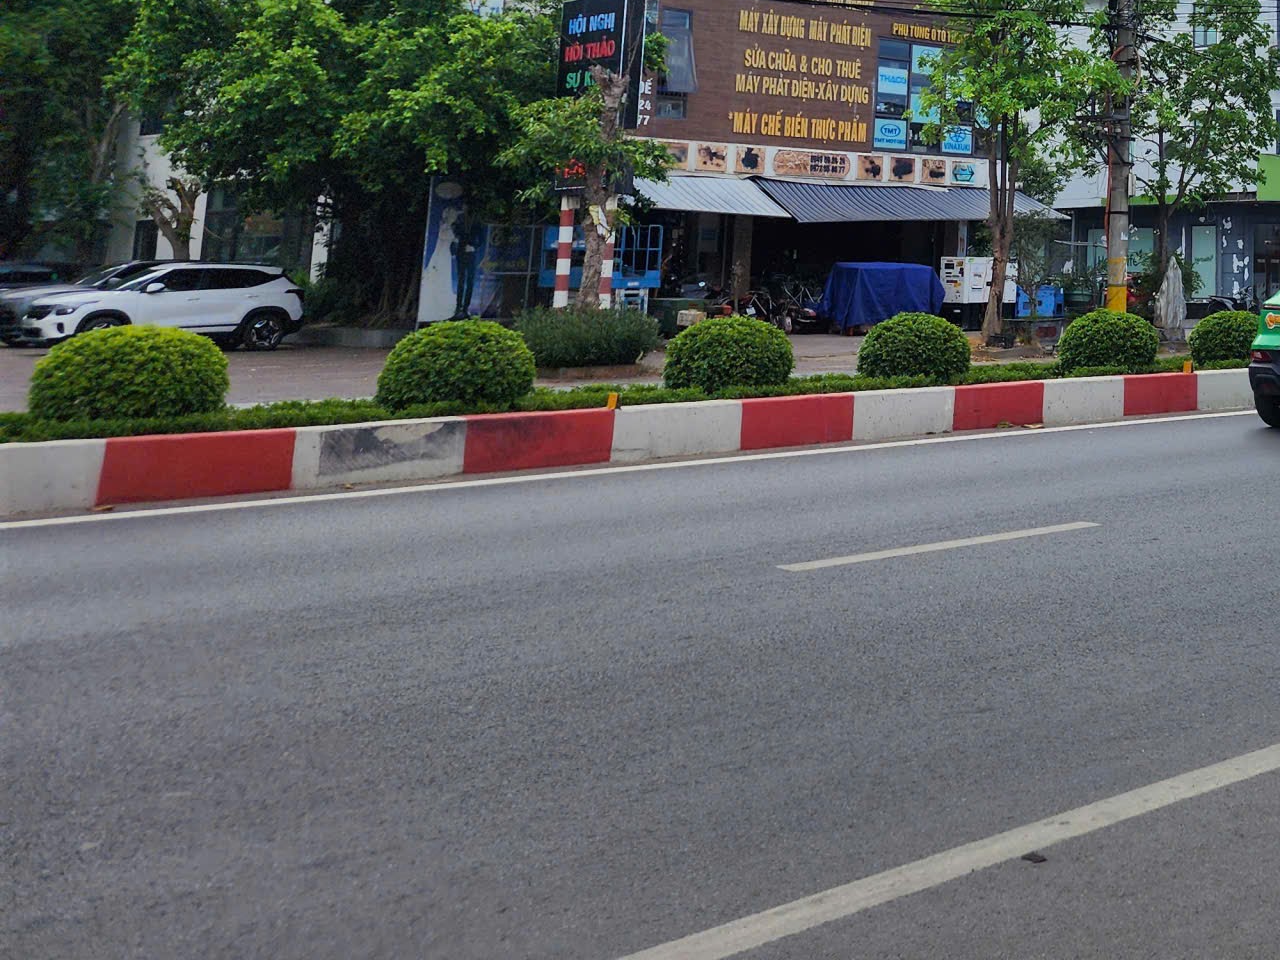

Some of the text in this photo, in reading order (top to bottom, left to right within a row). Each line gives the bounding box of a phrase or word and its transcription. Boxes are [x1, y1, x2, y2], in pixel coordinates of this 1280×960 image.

[568, 12, 616, 37] HỘI NGHỊ
[739, 7, 760, 34] MÁY
[761, 9, 780, 36] XÂY
[809, 16, 828, 42] MÁY
[799, 55, 808, 73] &
[811, 57, 833, 76] CHO
[836, 58, 862, 79] THUÊ
[735, 71, 761, 93] MÁY
[760, 109, 784, 137] CHẾ
[784, 111, 808, 139] BIẾN
[883, 127, 897, 136] TMT
